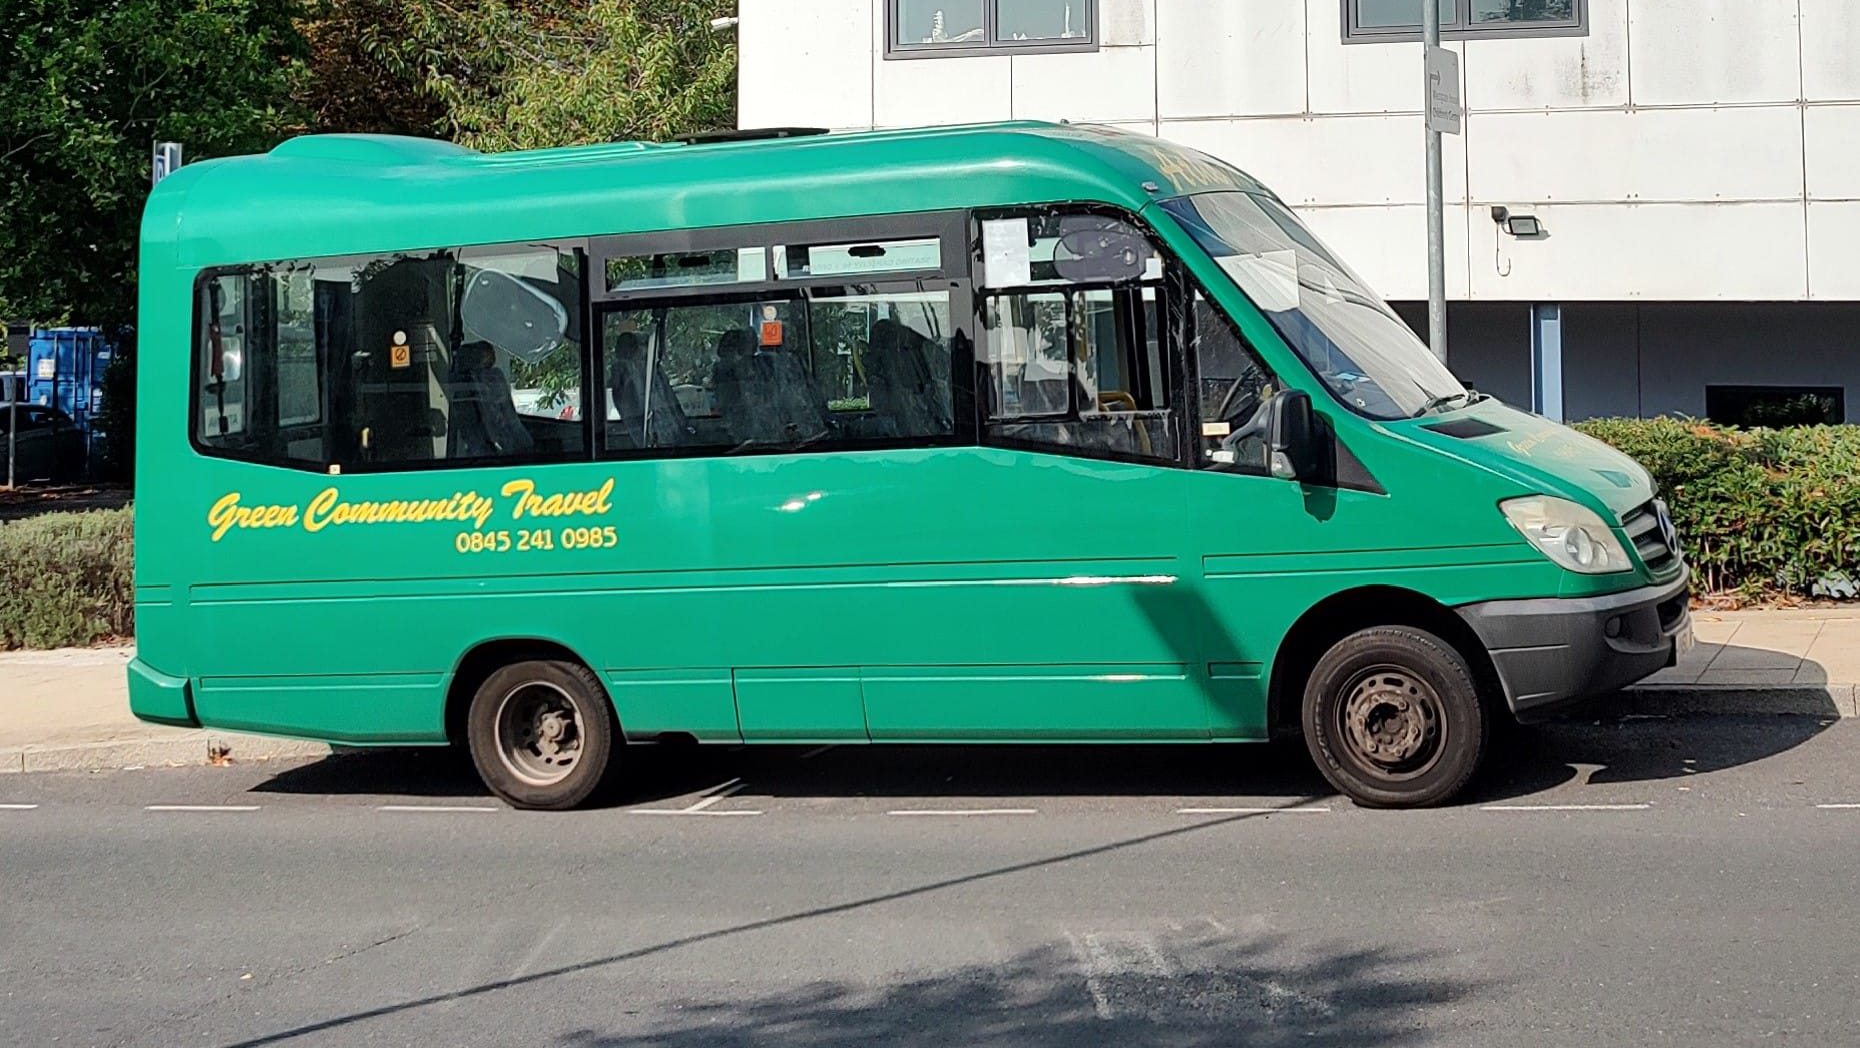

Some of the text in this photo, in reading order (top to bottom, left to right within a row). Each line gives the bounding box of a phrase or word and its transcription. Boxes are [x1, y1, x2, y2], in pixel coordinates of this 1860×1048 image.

[208, 478, 616, 542] Green Community Travel
[455, 526, 618, 553] 0845 241 0985
